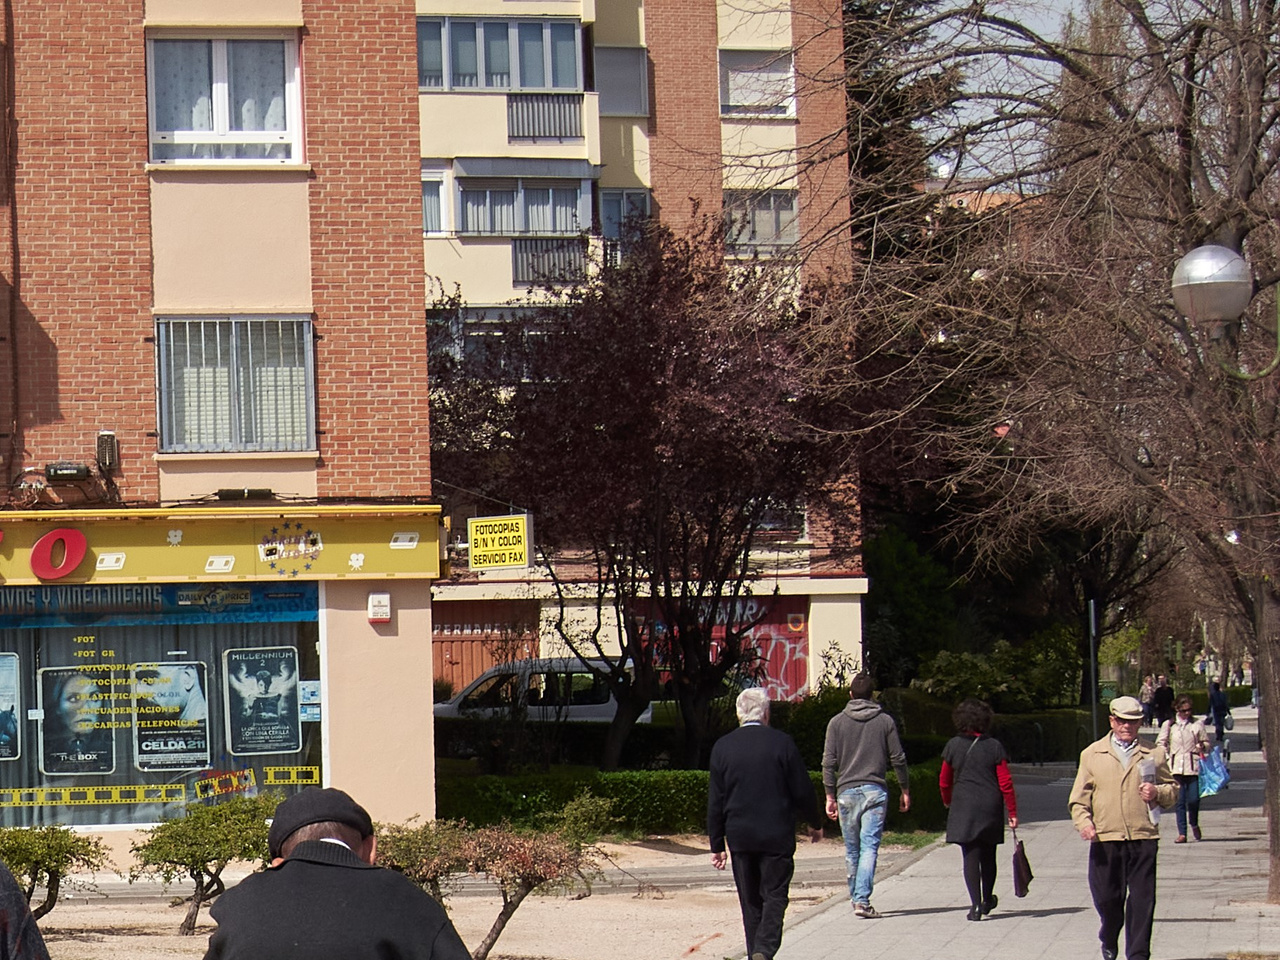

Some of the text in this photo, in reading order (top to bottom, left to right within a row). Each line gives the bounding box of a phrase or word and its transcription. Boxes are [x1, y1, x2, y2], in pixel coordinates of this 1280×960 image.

[475, 523, 520, 535] FOTOCOPIAS
[473, 535, 523, 549] B/N Y COLOR
[473, 552, 524, 565] SERVICIO FAX
[42, 587, 51, 612] Y
[57, 585, 162, 611] VIDEOJUEGOS
[225, 592, 250, 601] PRICE
[232, 652, 293, 660] MILLENNIUM
[79, 664, 138, 672] FOTOCOPIAS
[136, 719, 199, 728] TELEFONICAS
[141, 740, 206, 751] CELDA 211
